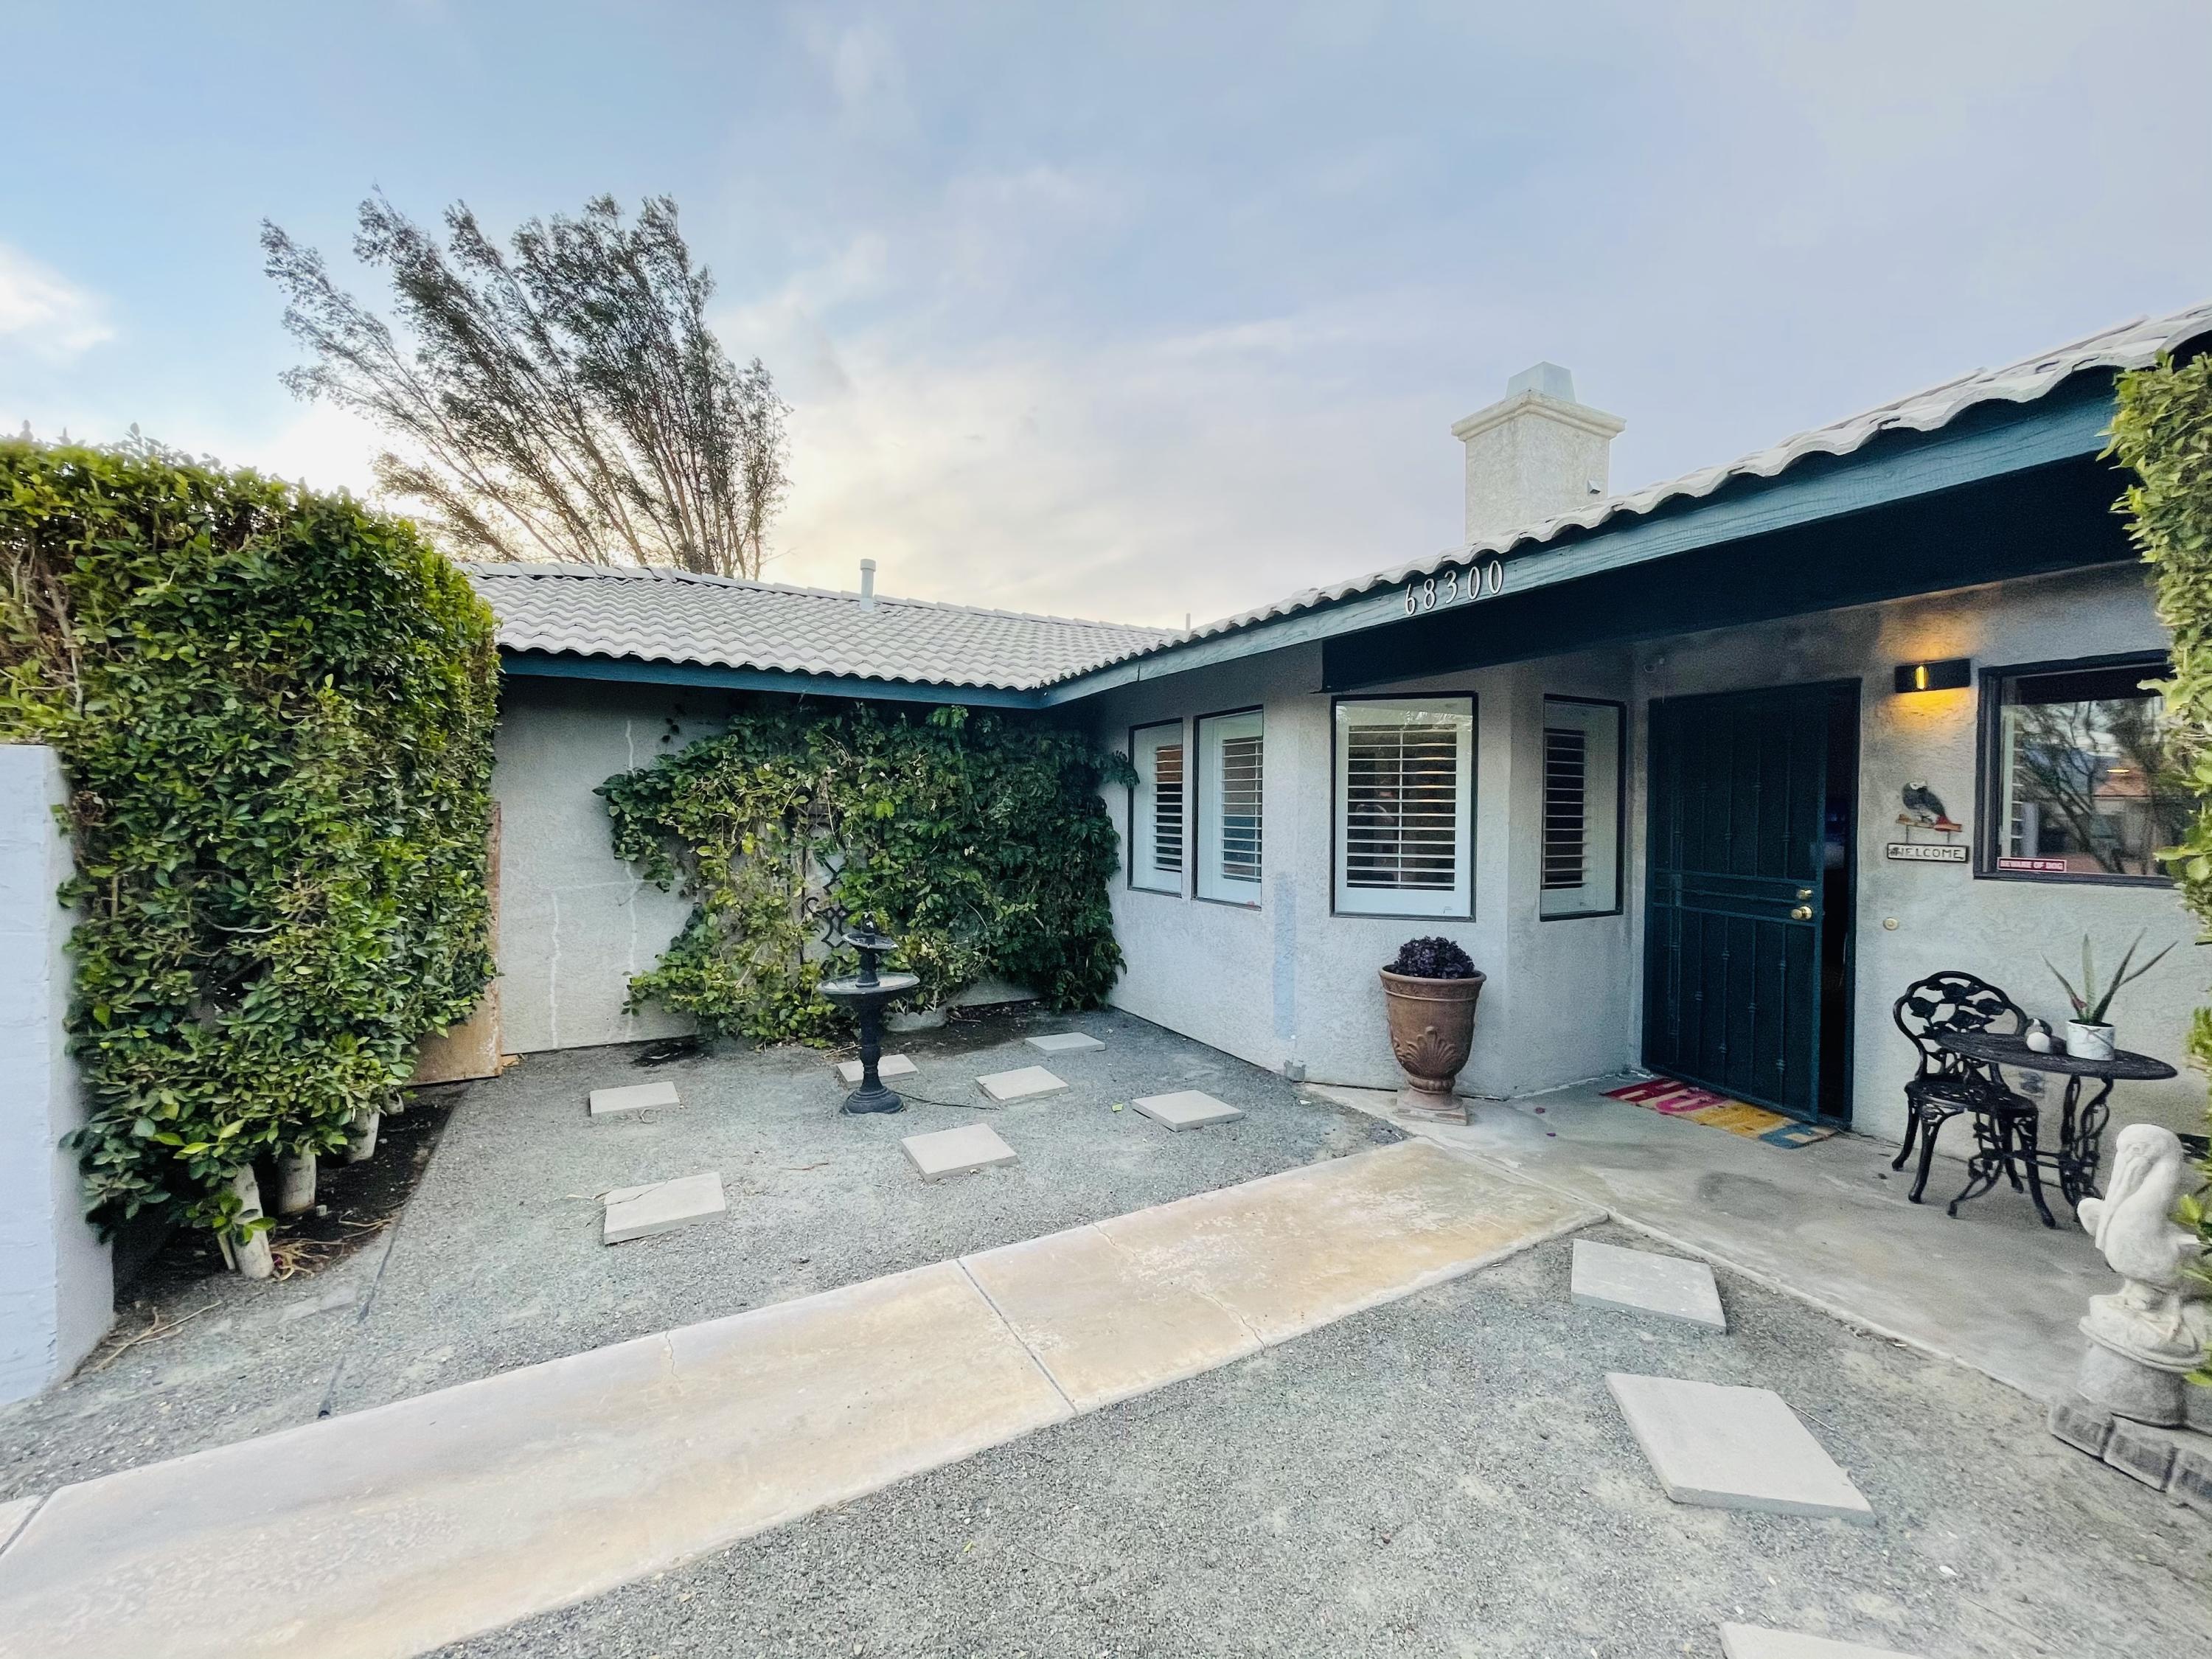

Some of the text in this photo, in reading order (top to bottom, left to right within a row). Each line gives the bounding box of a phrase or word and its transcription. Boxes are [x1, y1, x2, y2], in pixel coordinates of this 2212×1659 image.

[1405, 560, 1503, 615] 68300
[2000, 860, 2064, 870] BEWARE OF DOG
